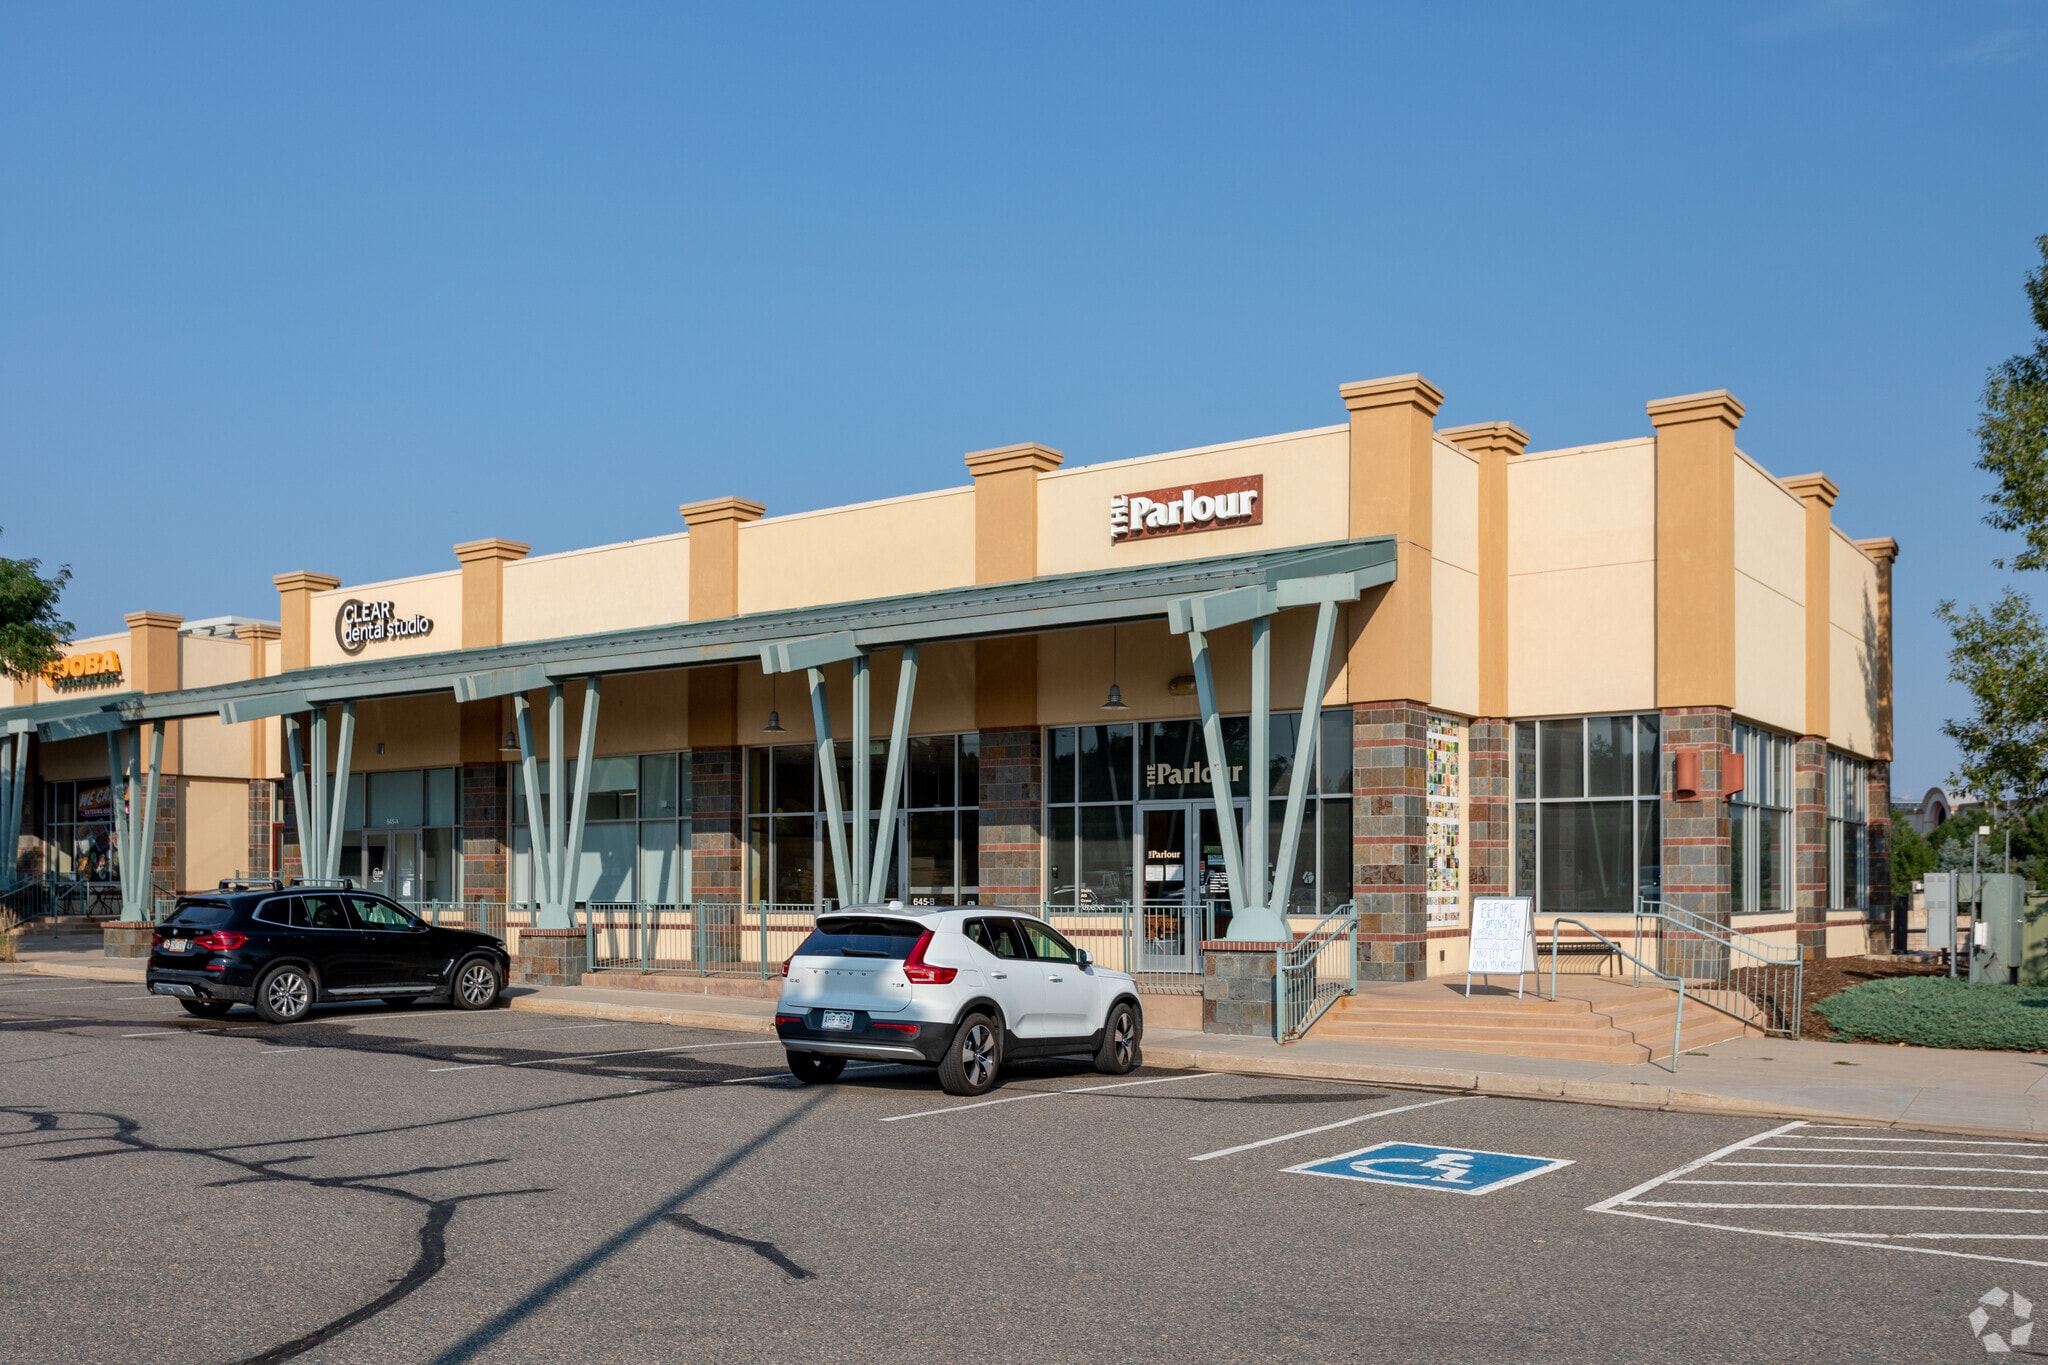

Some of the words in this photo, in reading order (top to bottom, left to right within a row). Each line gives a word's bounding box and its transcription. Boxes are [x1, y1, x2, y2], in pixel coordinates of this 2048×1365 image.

[1111, 495, 1128, 537] THE
[1130, 489, 1258, 531] Parlour
[344, 600, 390, 624] CLEAR
[344, 619, 385, 643] dental
[387, 614, 429, 637] studio
[1146, 763, 1156, 788] THE
[1157, 761, 1243, 785] Parlor
[80, 791, 96, 807] WE
[1152, 850, 1181, 859] Parlour
[913, 897, 935, 906] 645-B
[1481, 902, 1517, 918] BEFORE
